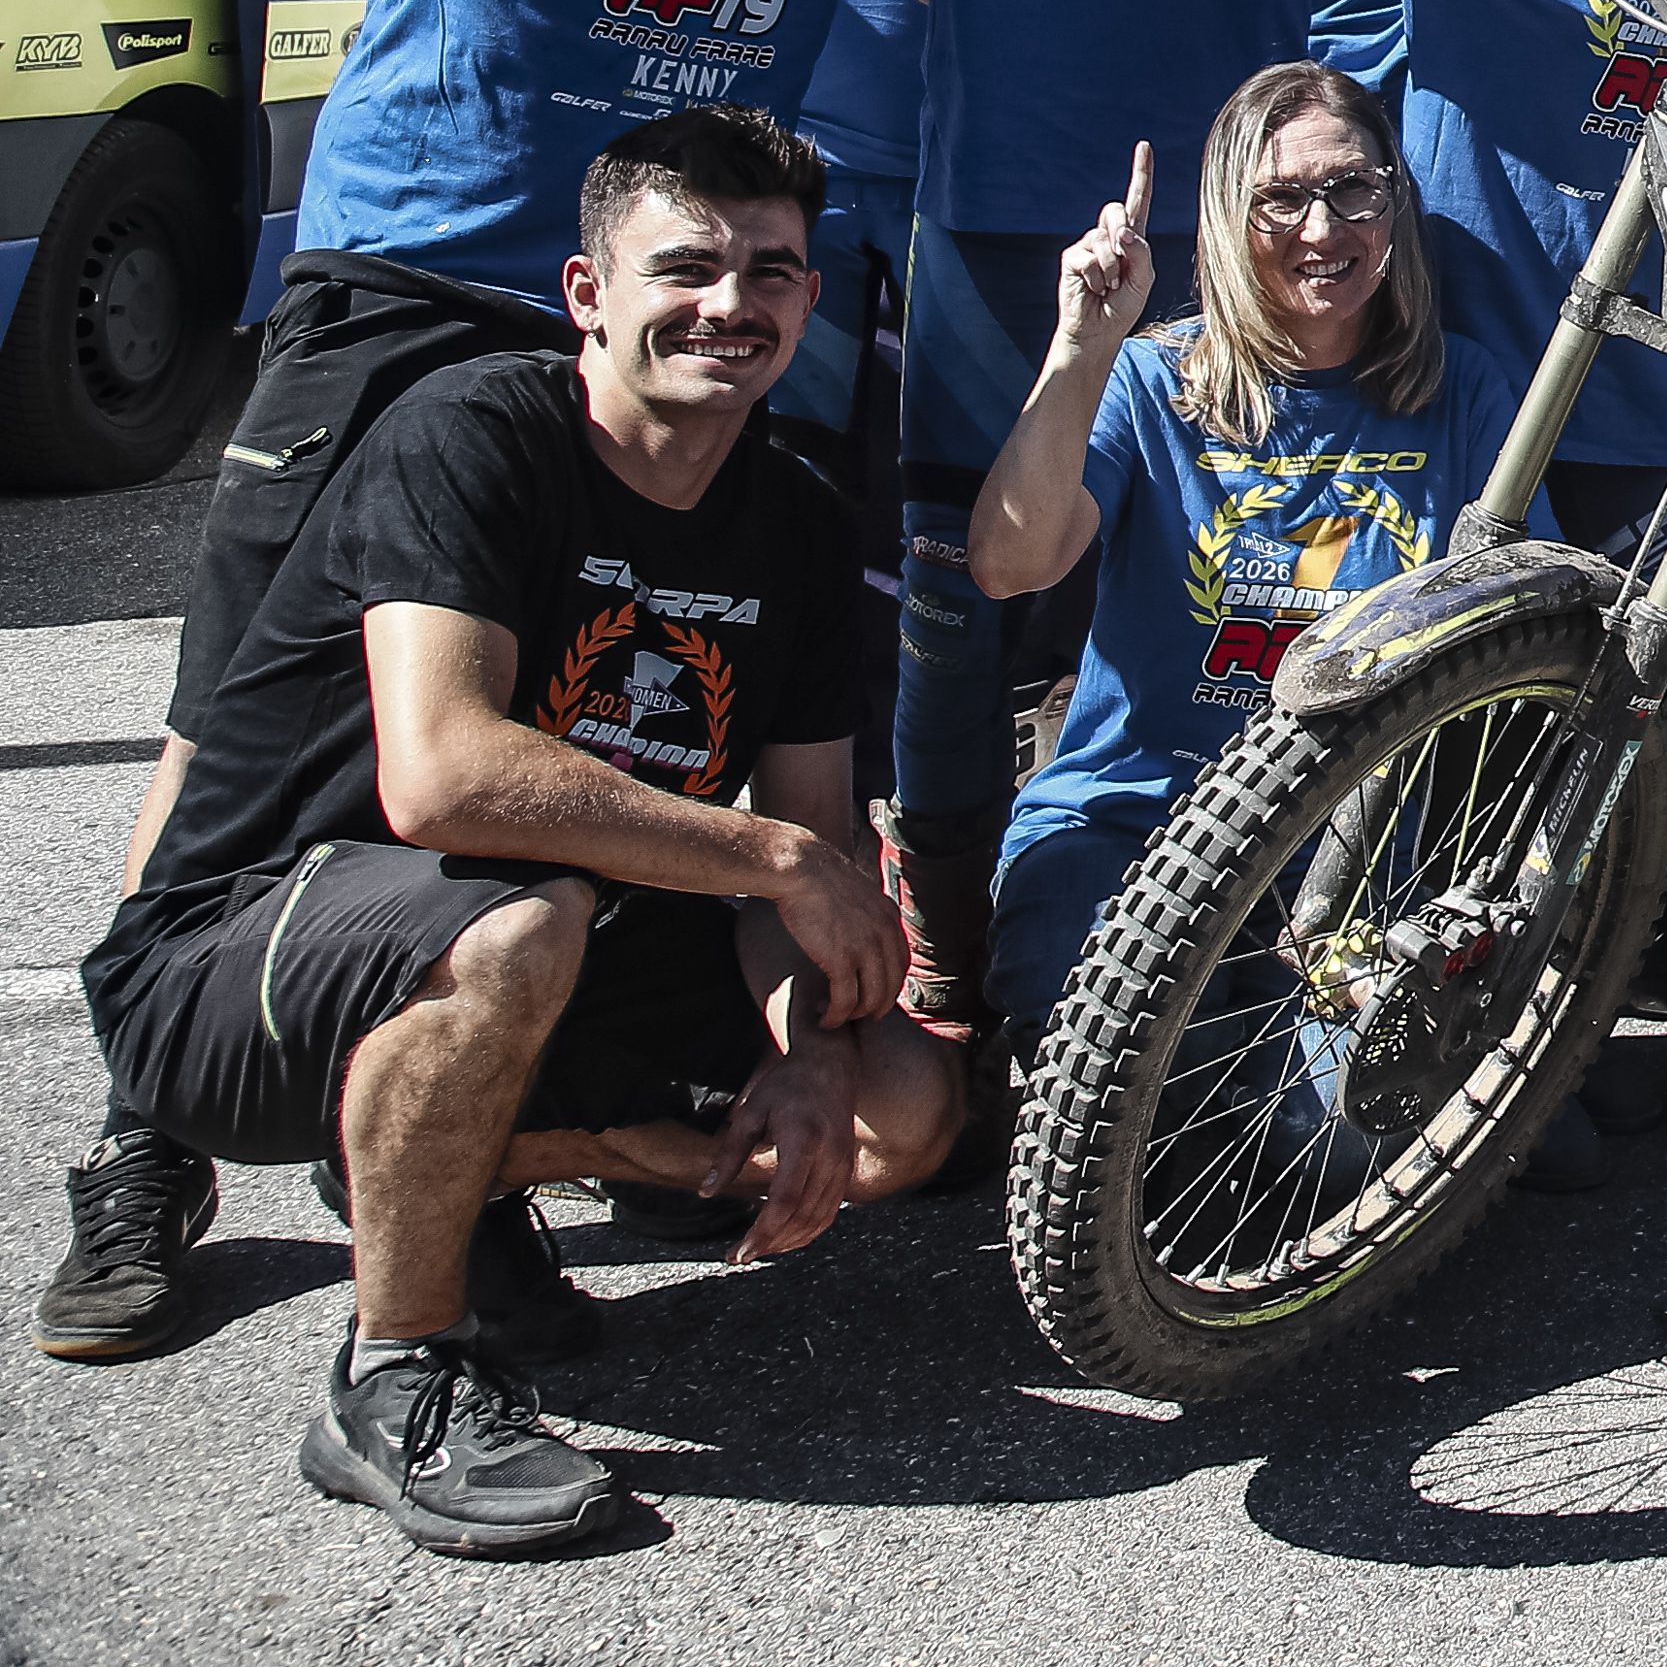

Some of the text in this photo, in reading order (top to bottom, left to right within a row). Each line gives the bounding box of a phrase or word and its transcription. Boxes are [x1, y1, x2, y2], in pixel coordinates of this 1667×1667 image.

[118, 34, 183, 53] Polisport
[631, 55, 738, 98] KENNY
[1195, 450, 1427, 476] SHERCO
[1229, 558, 1291, 581] 2026
[578, 555, 762, 625] SRPA
[1221, 584, 1355, 612] CHAMP
[1192, 682, 1272, 710] ARNA
[1585, 745, 1640, 850] MOTOREX
